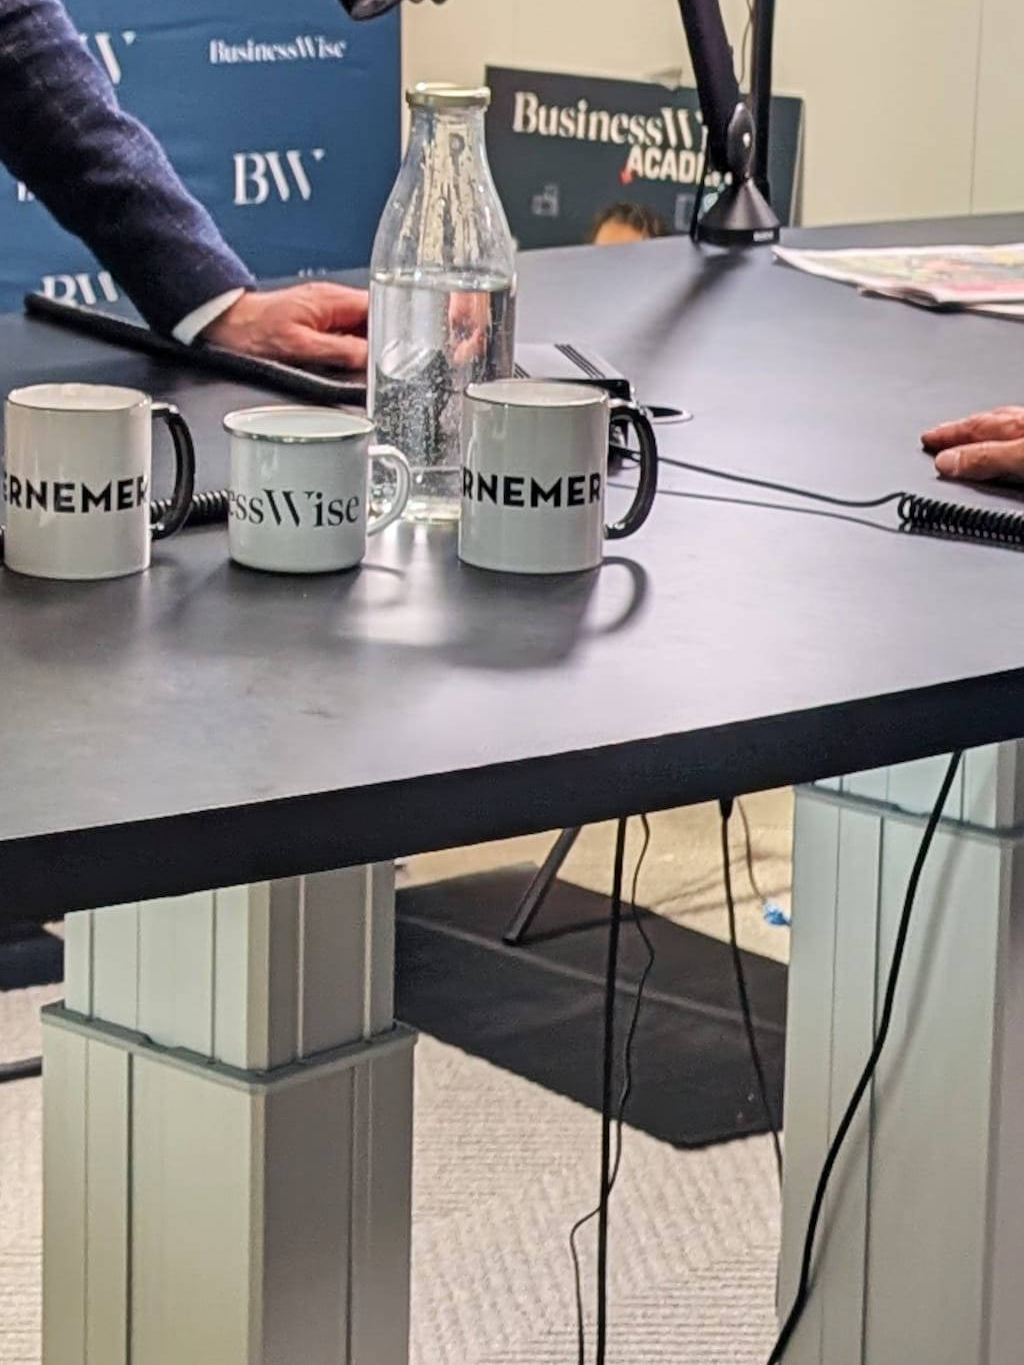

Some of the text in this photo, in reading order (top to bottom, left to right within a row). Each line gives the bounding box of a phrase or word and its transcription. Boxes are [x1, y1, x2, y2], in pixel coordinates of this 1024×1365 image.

[209, 36, 346, 64] BusinessWise
[512, 91, 709, 150] BusinessWi
[233, 148, 324, 205] BW
